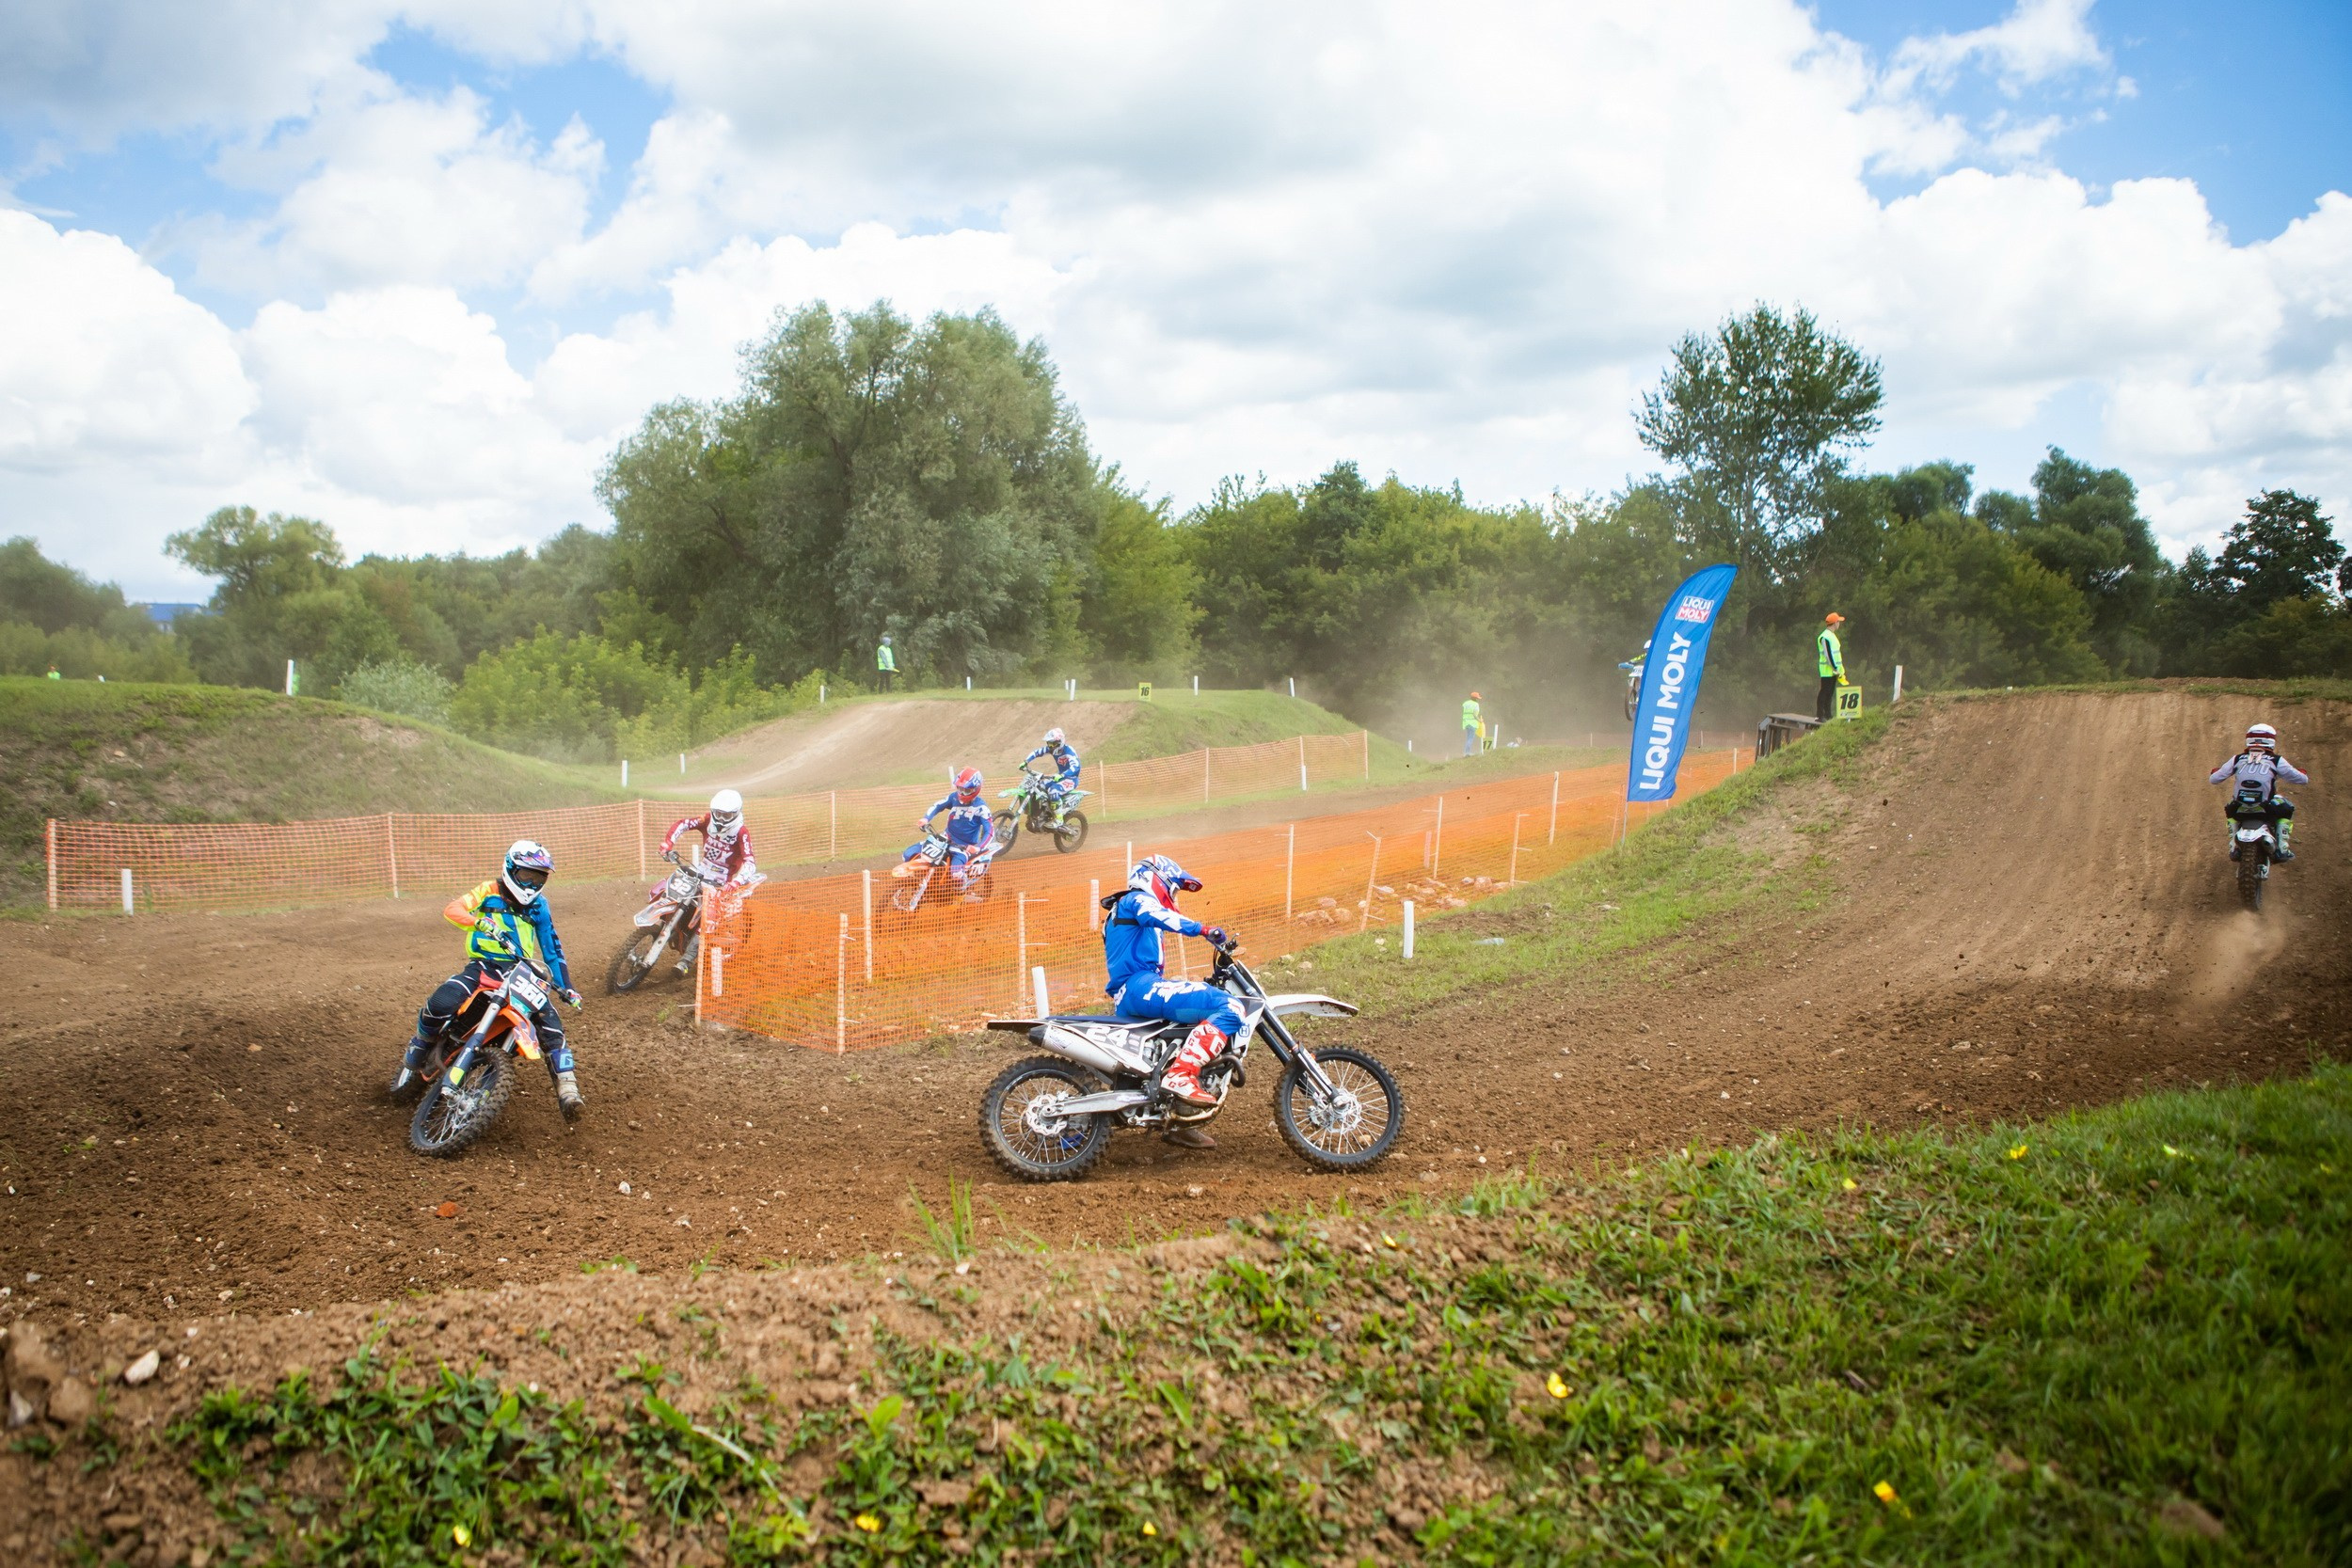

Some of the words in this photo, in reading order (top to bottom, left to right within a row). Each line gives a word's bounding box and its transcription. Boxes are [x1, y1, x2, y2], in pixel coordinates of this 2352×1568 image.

[1682, 597, 1712, 610] LIQUI
[1677, 608, 1709, 621] MOLY
[1657, 632, 1692, 709] MOLY
[1140, 687, 1150, 696] 16
[1840, 693, 1859, 709] 18
[1483, 740, 1493, 750] 17
[1639, 716, 1676, 790] LIQUI
[922, 844, 942, 859] 170
[669, 879, 692, 895] 32
[510, 974, 548, 1010] 360
[1086, 1025, 1129, 1047] 24
